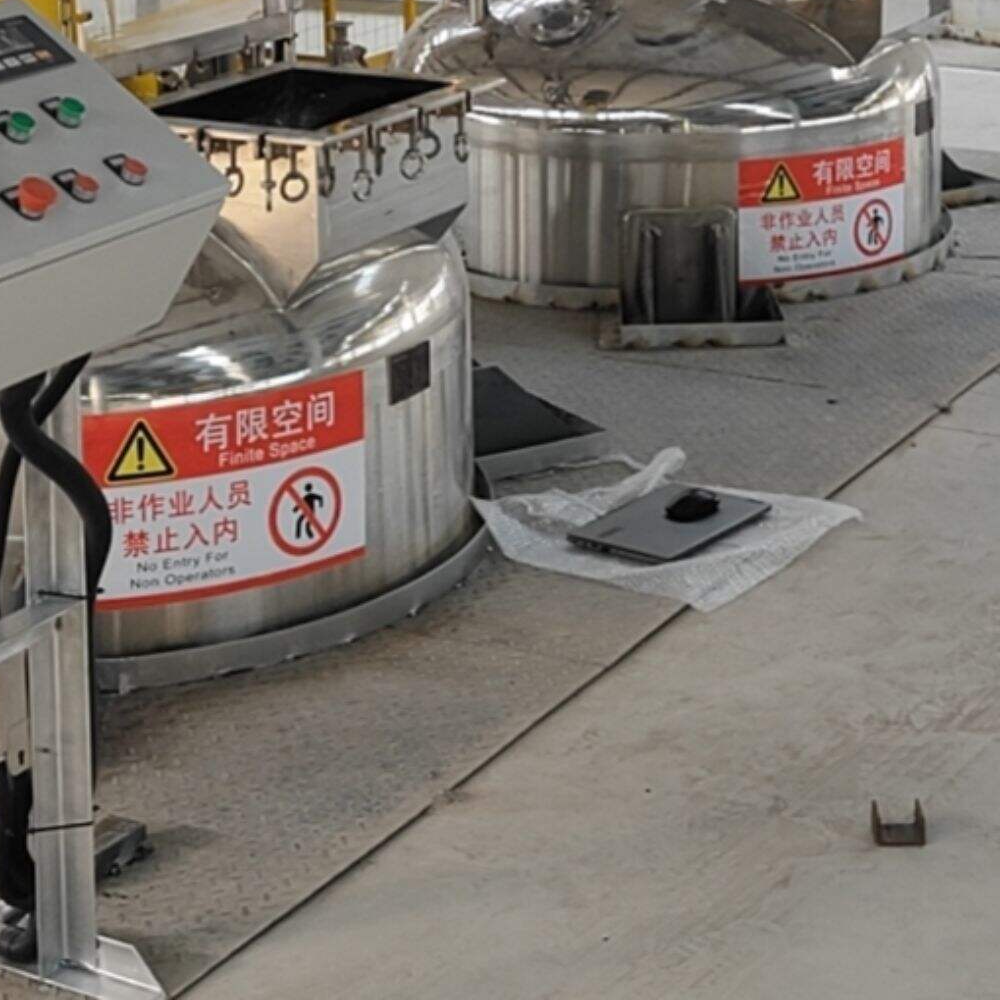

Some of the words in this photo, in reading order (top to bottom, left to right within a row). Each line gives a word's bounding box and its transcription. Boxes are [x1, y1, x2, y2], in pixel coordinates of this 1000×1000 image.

[195, 391, 334, 452] 有限空间
[218, 448, 264, 467] Finite
[269, 437, 316, 458] Space
[110, 480, 252, 524] 非作业人员
[123, 517, 238, 558] 禁止入内
[130, 578, 160, 590] Non
[165, 566, 236, 586] Operators
[137, 562, 157, 573] No
[163, 557, 200, 571] Entry
[205, 551, 229, 563] For
